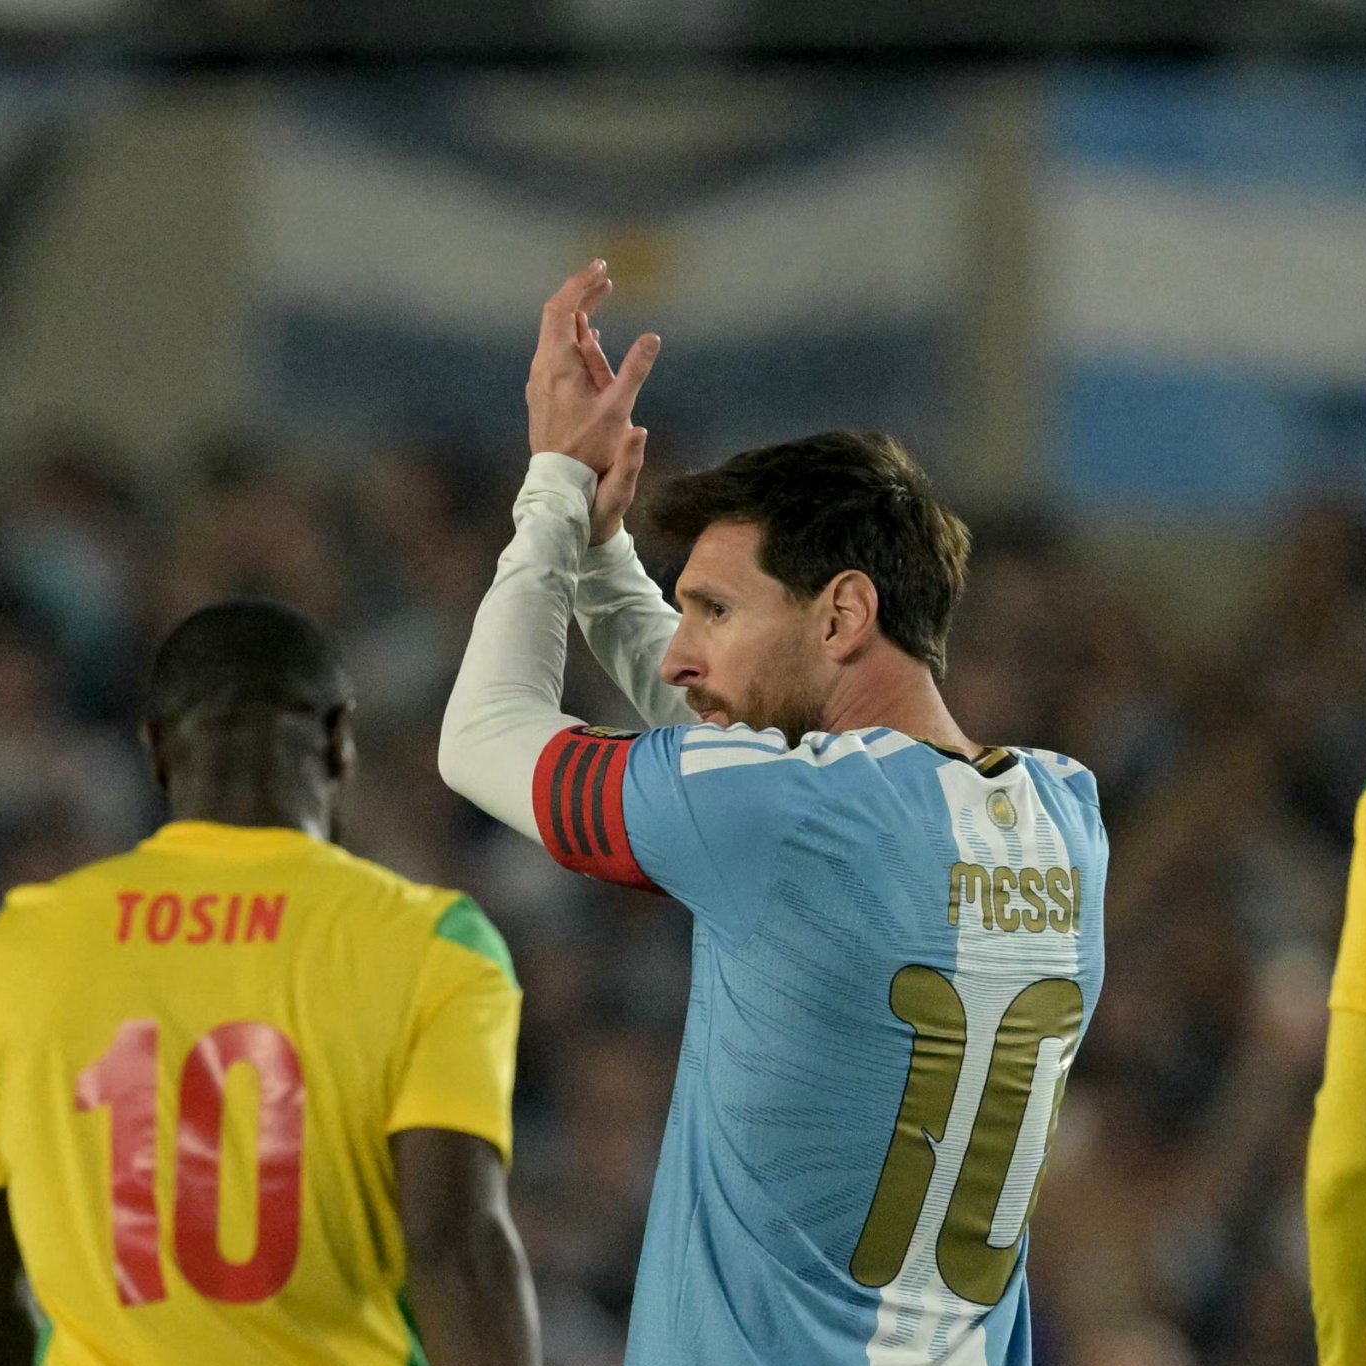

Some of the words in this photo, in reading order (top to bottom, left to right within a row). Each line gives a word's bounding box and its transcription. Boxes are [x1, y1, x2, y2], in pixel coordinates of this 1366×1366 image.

[115, 891, 287, 945] TOSIN
[948, 861, 1081, 933] MESSI
[74, 1017, 306, 1308] 10
[849, 965, 1084, 1305] 10
